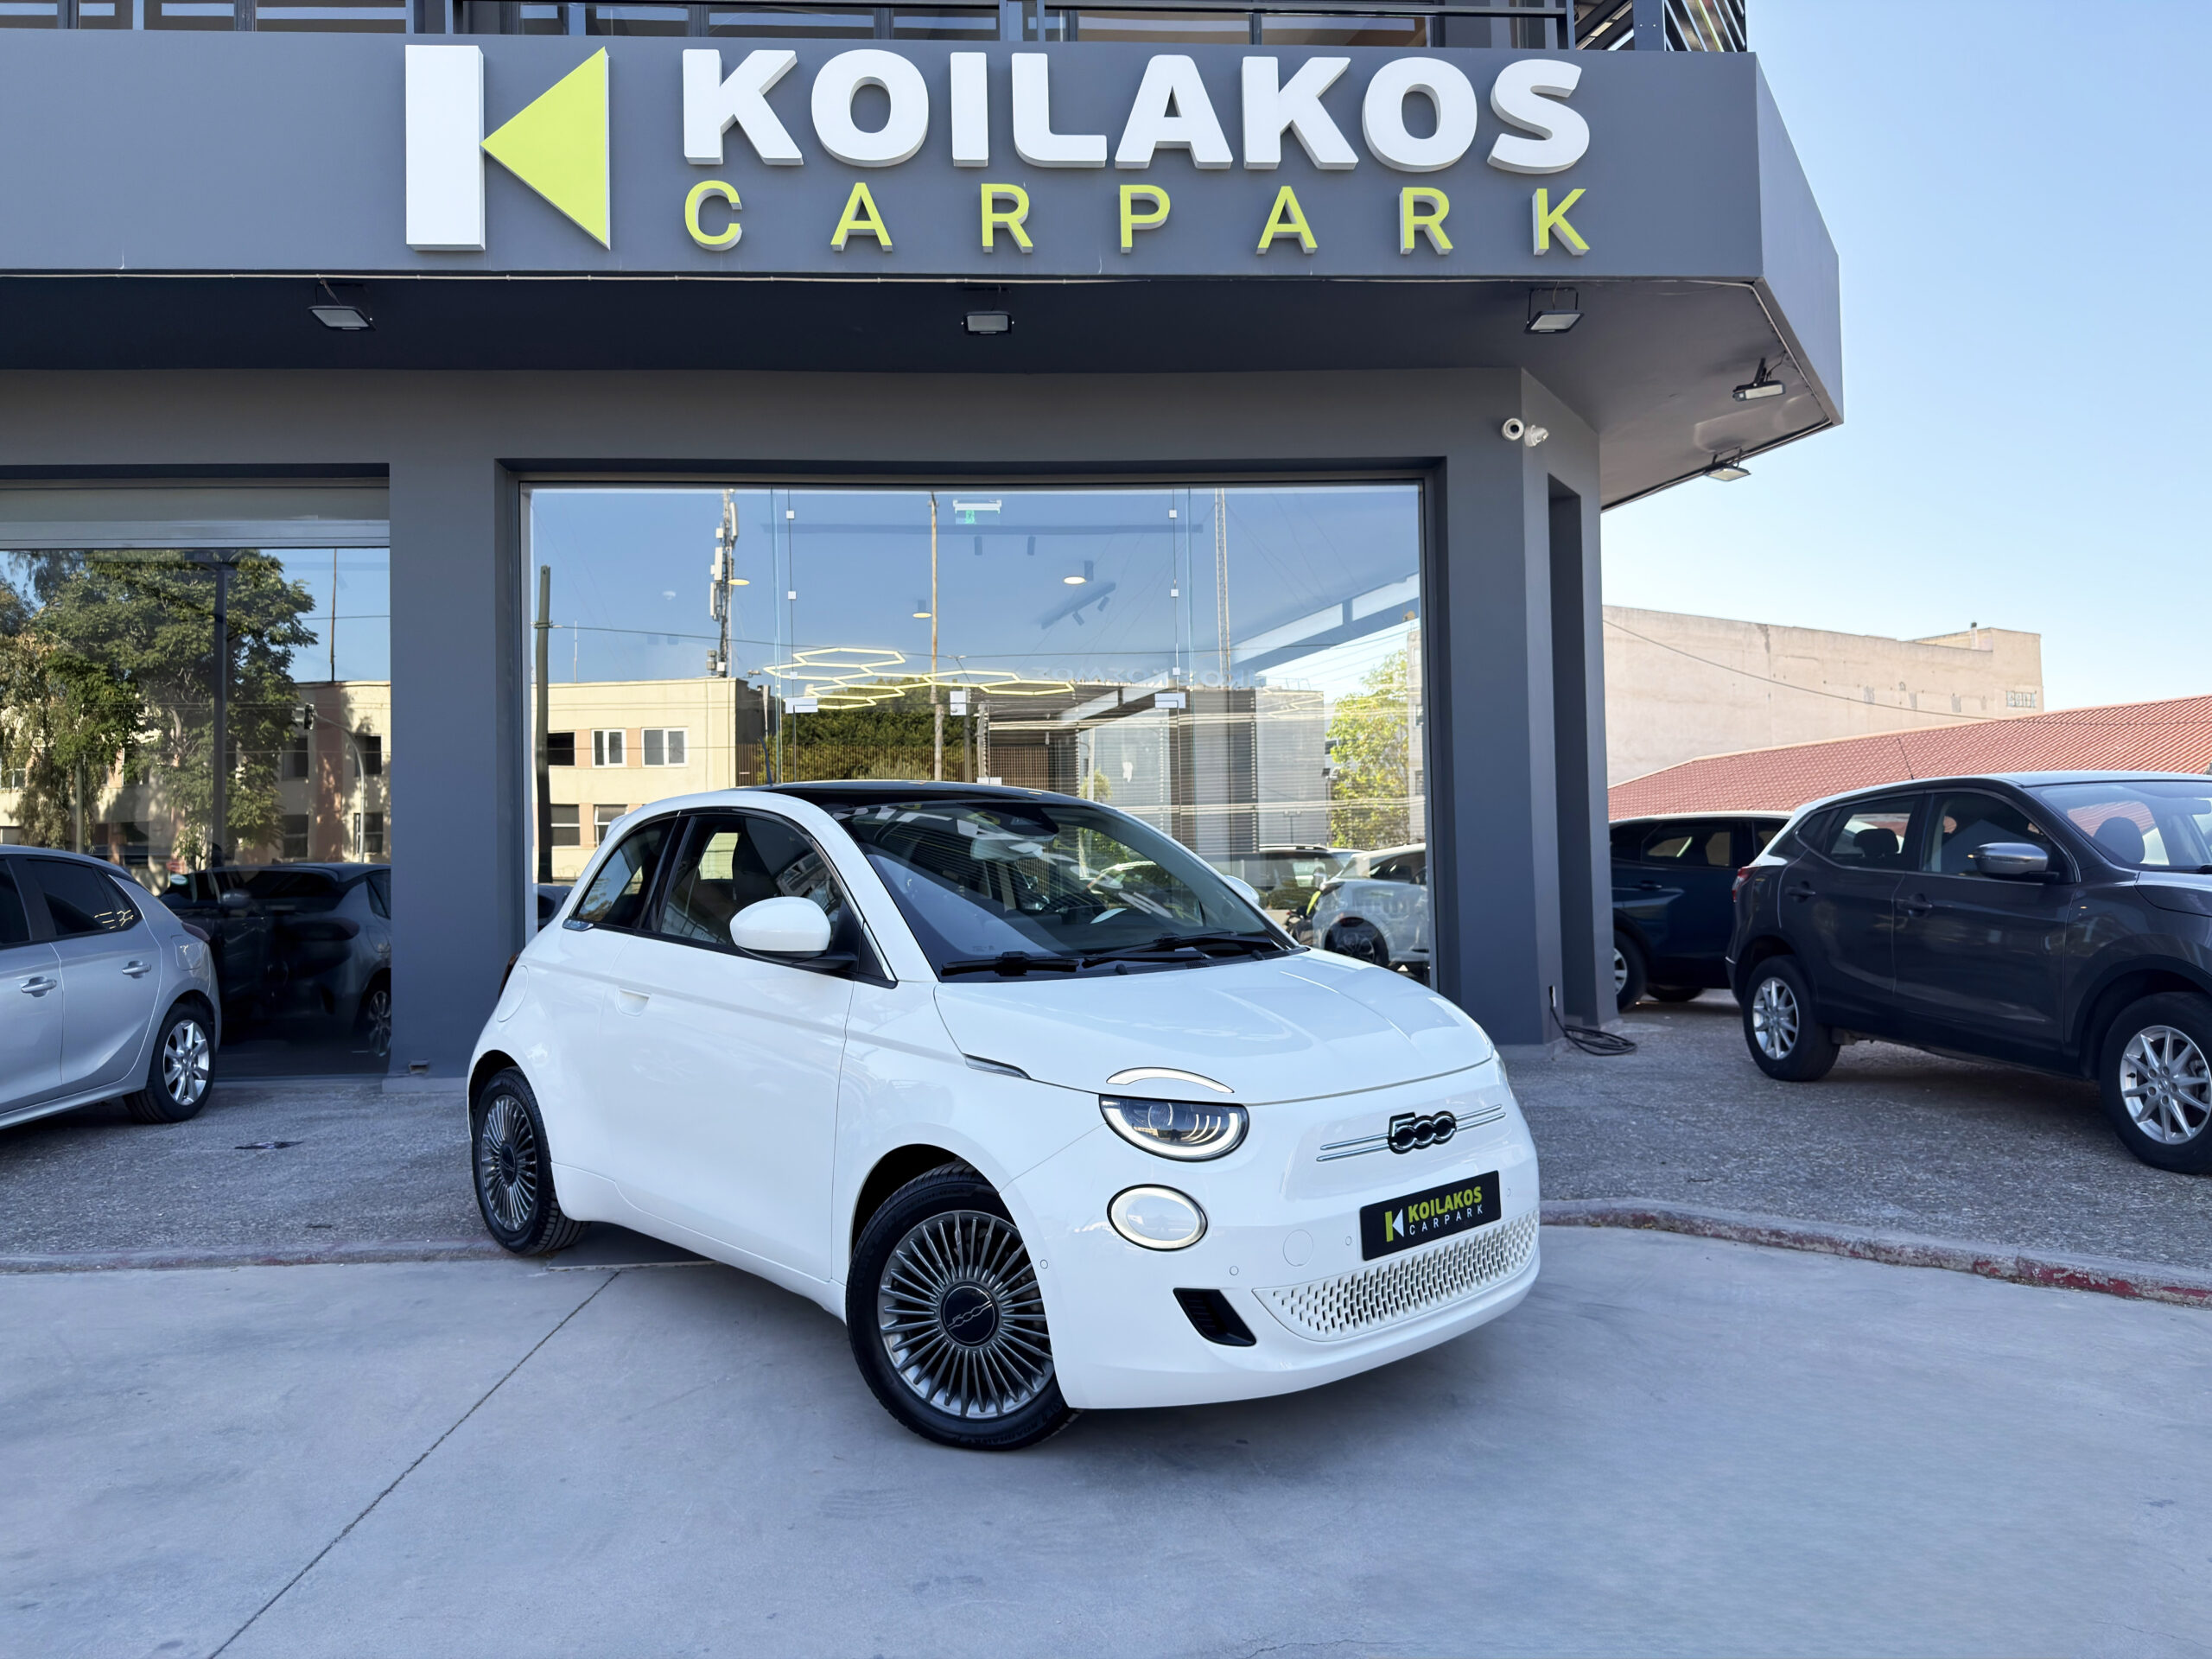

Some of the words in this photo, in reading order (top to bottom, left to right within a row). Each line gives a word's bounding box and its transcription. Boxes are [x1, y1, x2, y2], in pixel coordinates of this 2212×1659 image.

[682, 48, 1591, 175] KOILAKOS
[684, 180, 1591, 256] CARPARK
[1388, 1110, 1457, 1154] 500
[1408, 1185, 1483, 1224] KOILAKOS
[1409, 1204, 1484, 1236] CARPARK
